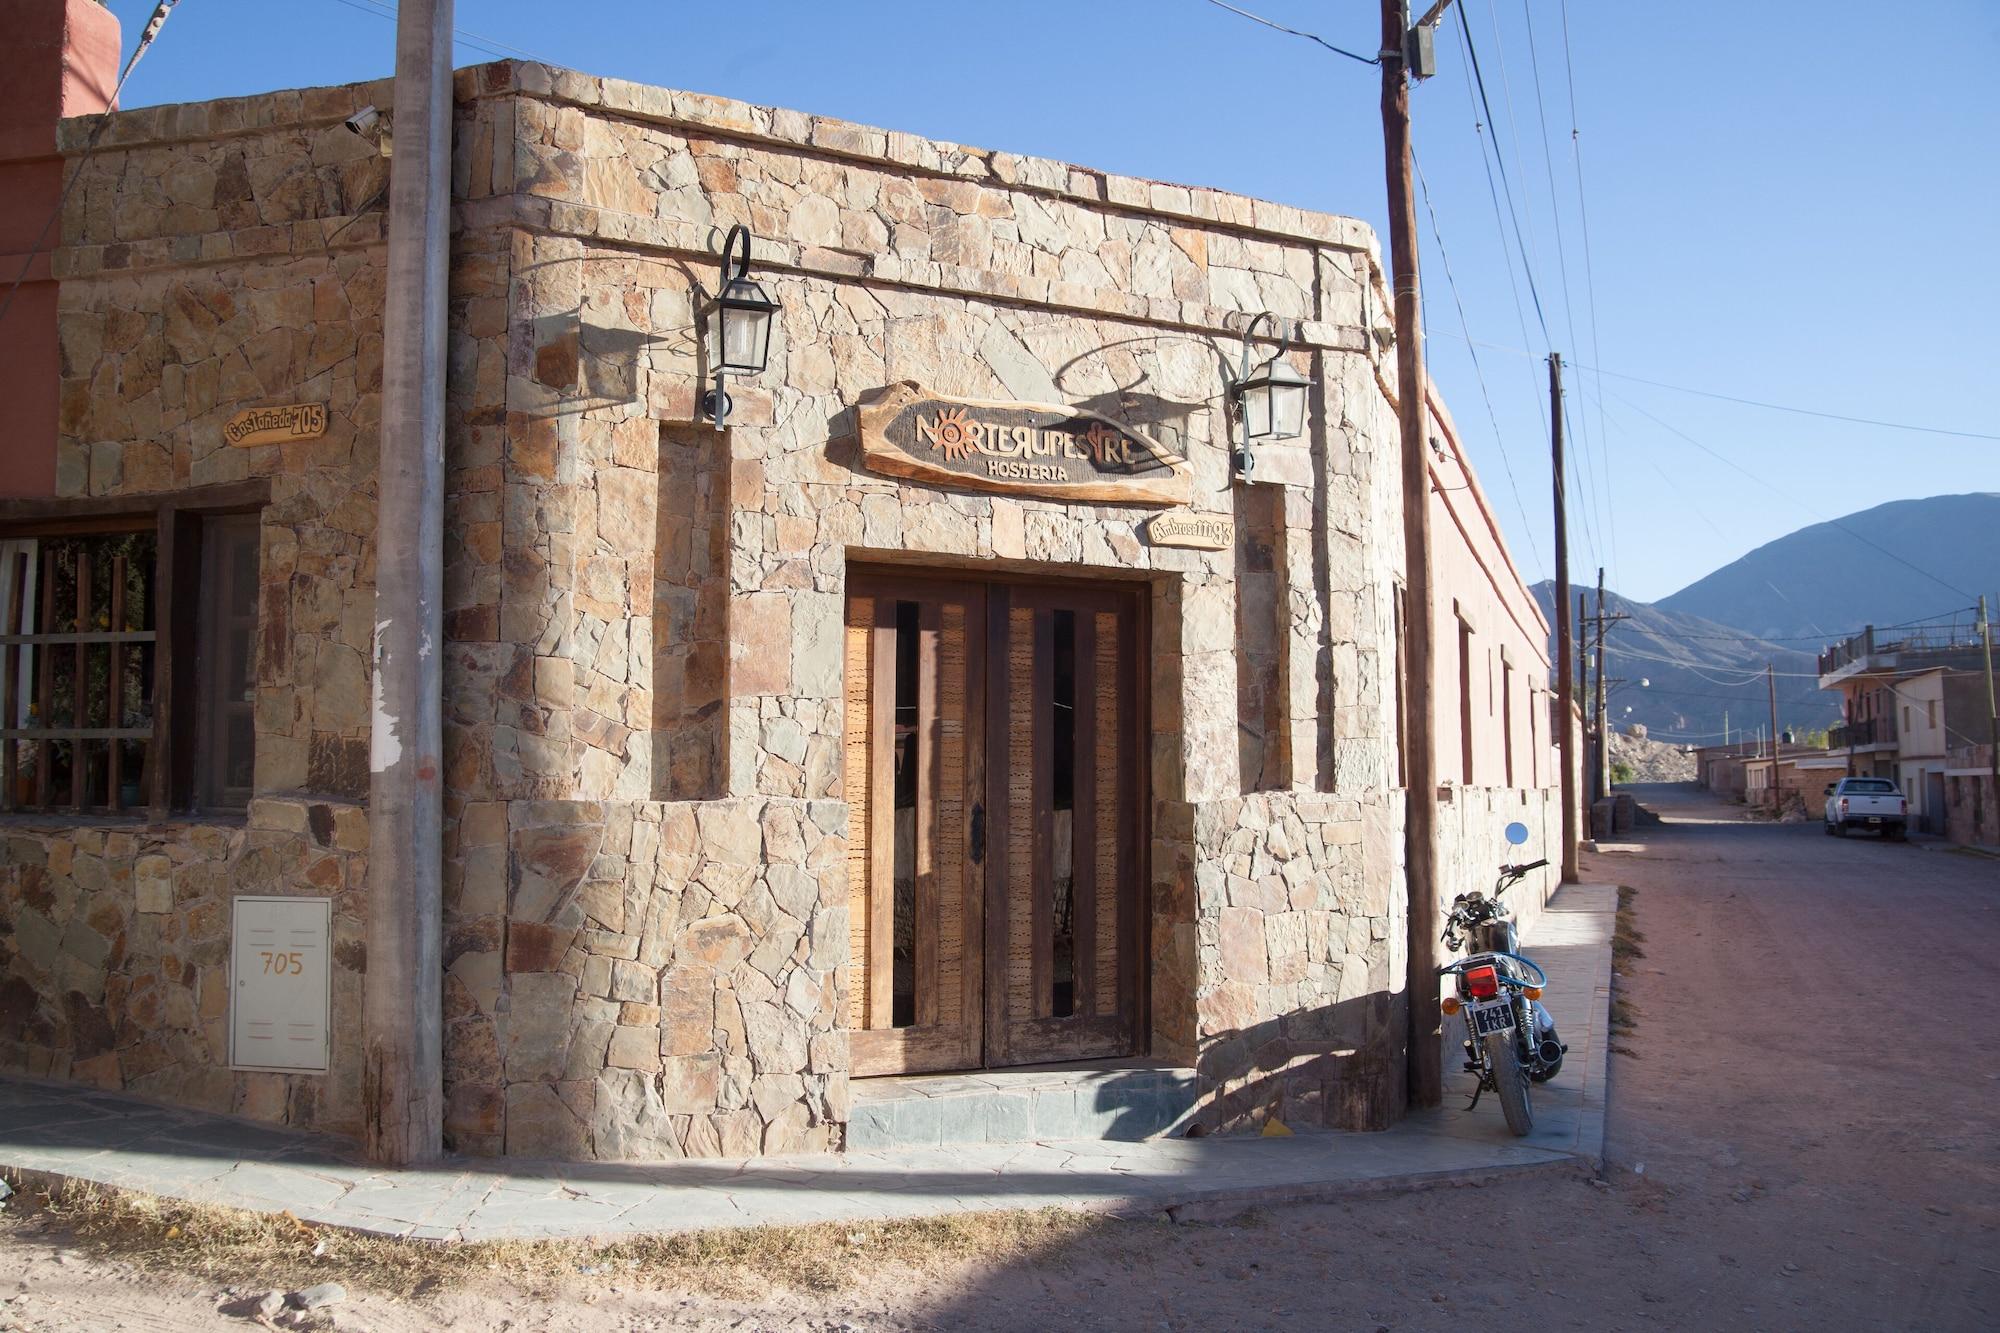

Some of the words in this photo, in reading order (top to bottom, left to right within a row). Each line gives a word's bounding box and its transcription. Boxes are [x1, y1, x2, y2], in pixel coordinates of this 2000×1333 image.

[291, 405, 323, 435] 705
[986, 460, 1069, 482] HOSTERIA
[1153, 517, 1213, 541] Ambrosetti
[1212, 521, 1234, 546] 93
[260, 952, 303, 975] 705
